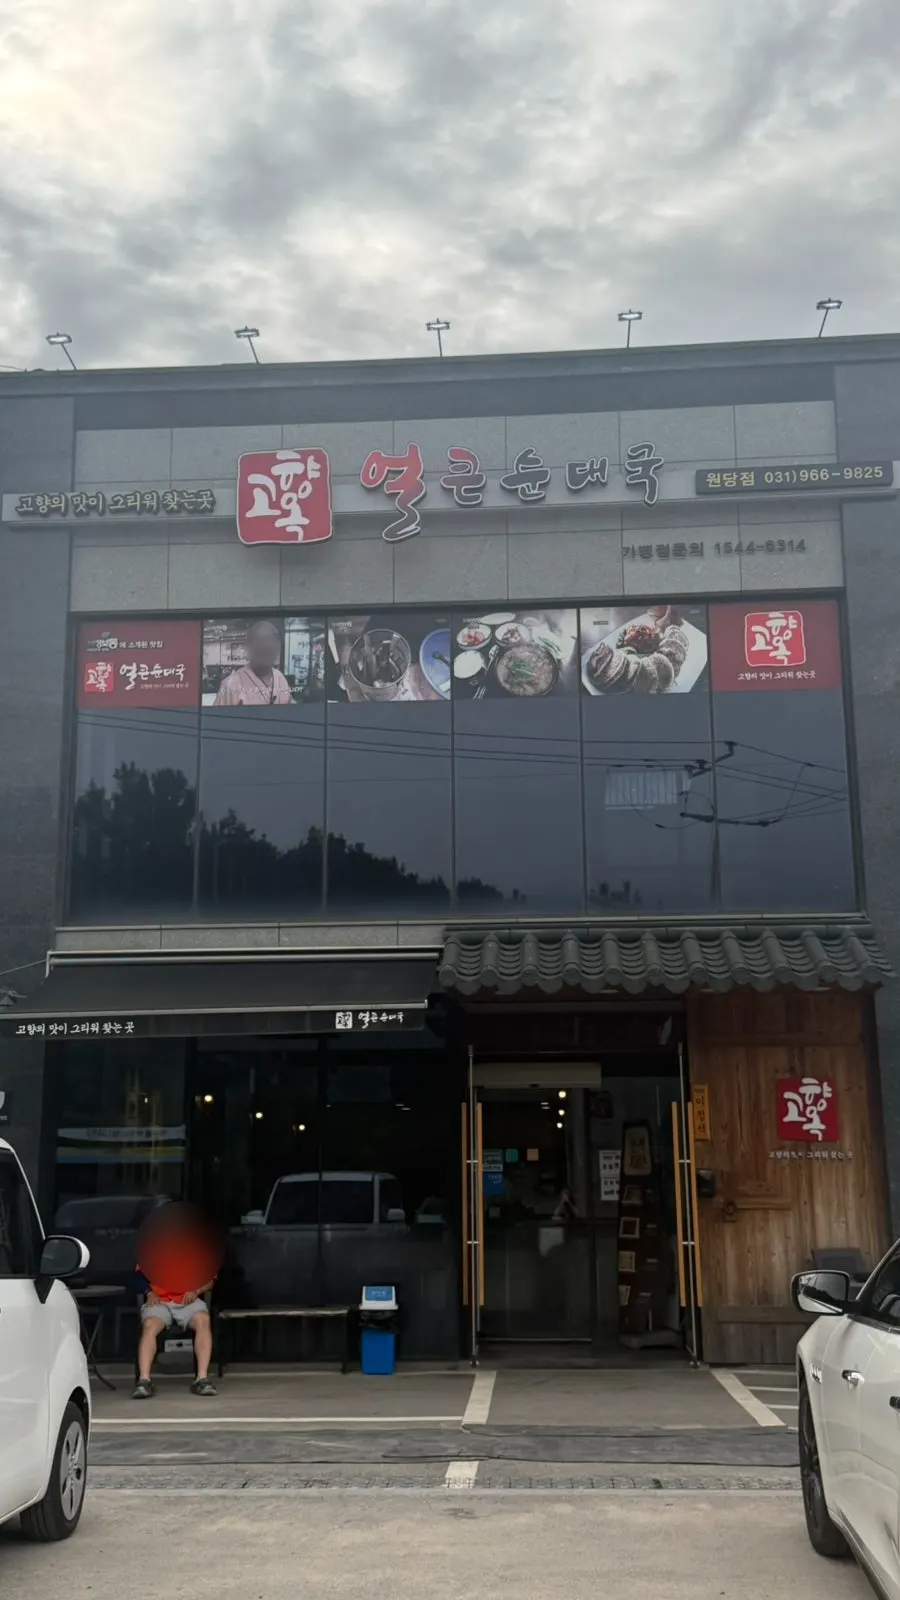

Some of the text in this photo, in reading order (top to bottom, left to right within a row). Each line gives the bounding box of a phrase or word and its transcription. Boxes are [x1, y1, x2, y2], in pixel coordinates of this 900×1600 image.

[705, 465, 884, 488] 원당점 031)966-9825
[16, 492, 66, 515] 고향의
[71, 491, 105, 514] 맛이
[108, 490, 158, 513] 그리워
[244, 448, 323, 542] 고향옥
[714, 538, 807, 555] 1544-6314
[751, 611, 798, 665] 고향옥
[15, 1023, 46, 1036] 고향의
[48, 1022, 68, 1035] 맛이
[70, 1021, 100, 1034] 그리워
[124, 1021, 135, 1034] 곳
[782, 1077, 833, 1142] 고향옥
